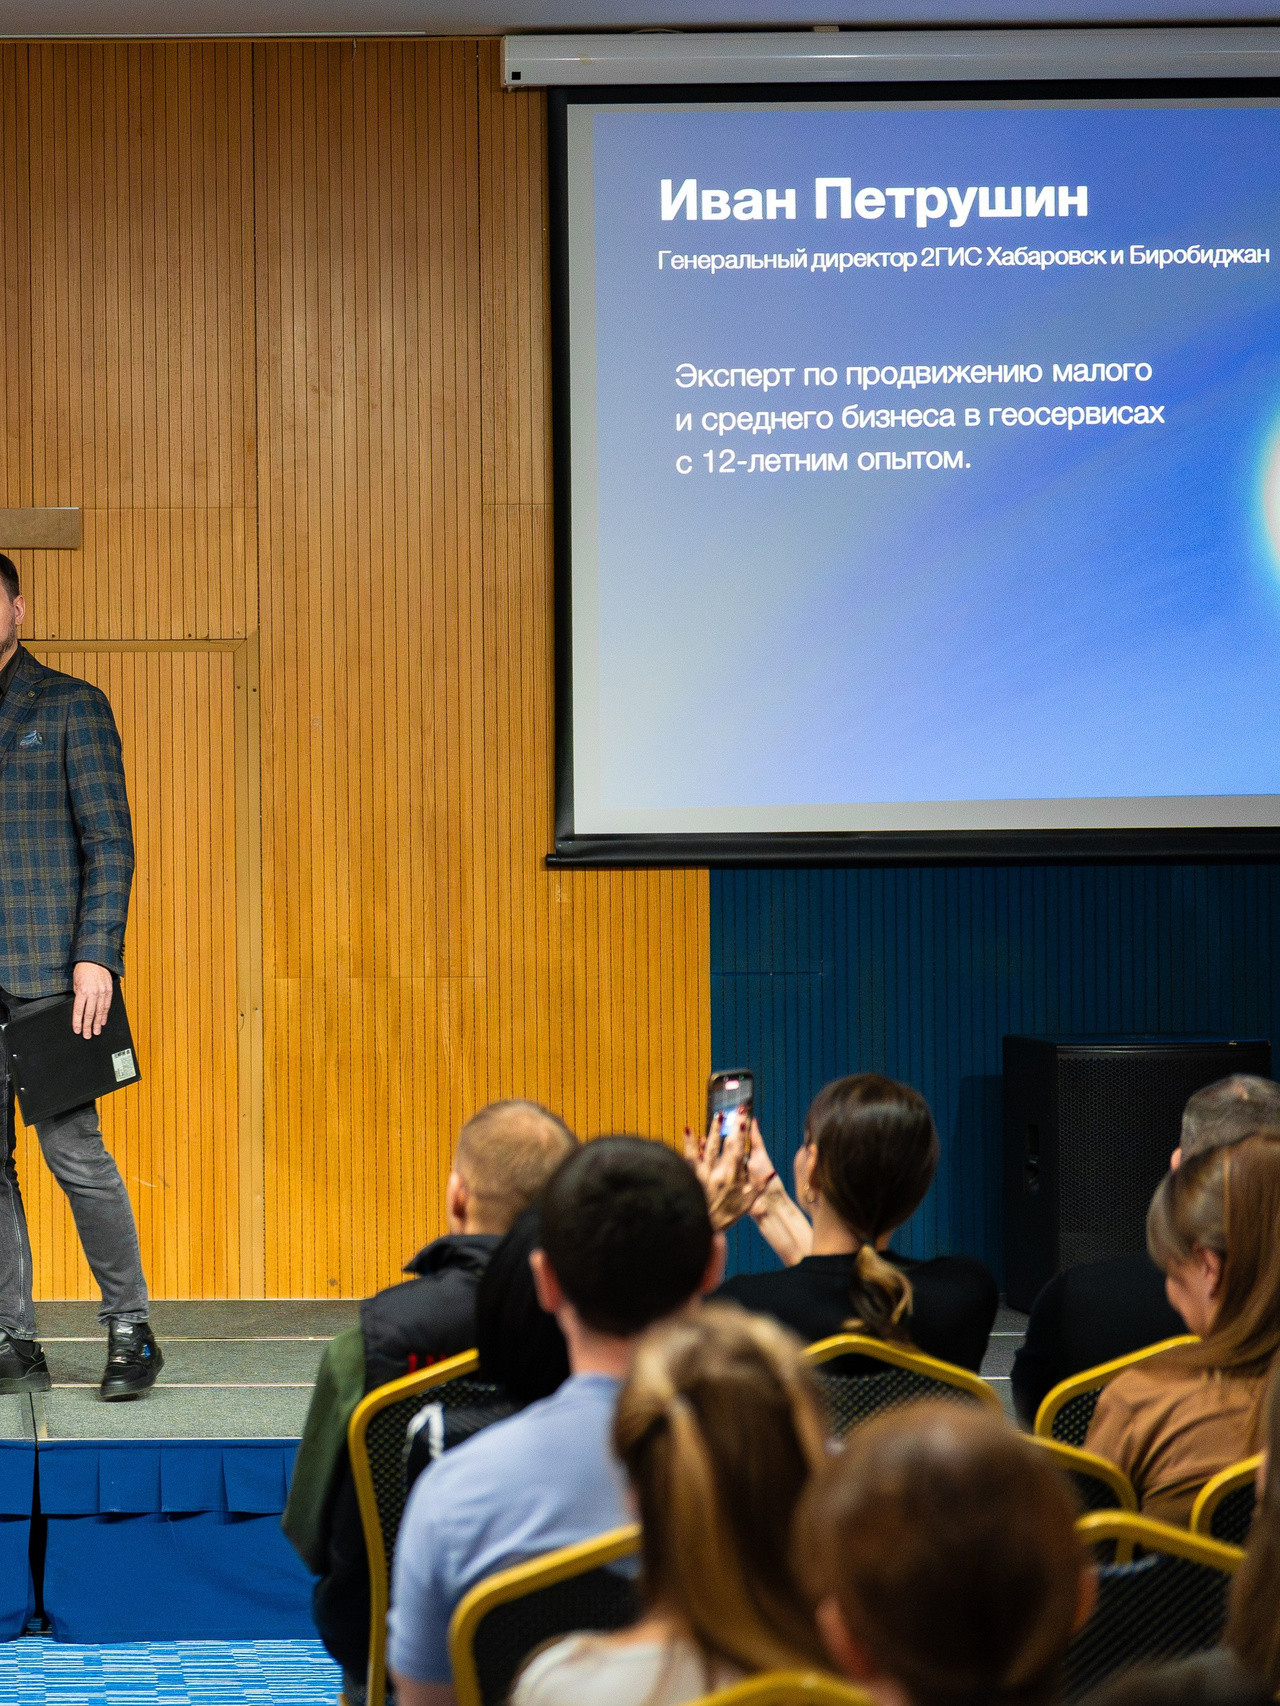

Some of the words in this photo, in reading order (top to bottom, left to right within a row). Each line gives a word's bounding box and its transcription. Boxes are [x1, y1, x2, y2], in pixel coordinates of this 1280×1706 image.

[660, 178, 796, 221] Иван
[815, 177, 1088, 229] Петрушин
[658, 248, 808, 275] Генеральный
[810, 252, 918, 273] директор
[921, 246, 983, 267] 2ГИС
[986, 246, 1107, 271] Хабаровск
[1110, 249, 1124, 265] и
[1130, 244, 1270, 269] Биробиджан
[675, 363, 796, 392] Эксперт
[803, 366, 838, 386] по
[846, 364, 1043, 391] продвижению
[1052, 362, 1153, 382] малого
[676, 412, 692, 432] и
[701, 410, 834, 437] среднего
[841, 403, 956, 429] бизнеса
[964, 408, 981, 427] в
[989, 405, 1165, 431] геосервисах
[675, 455, 693, 475] с
[702, 448, 848, 474] 12-летним
[857, 450, 972, 471] опытом.
